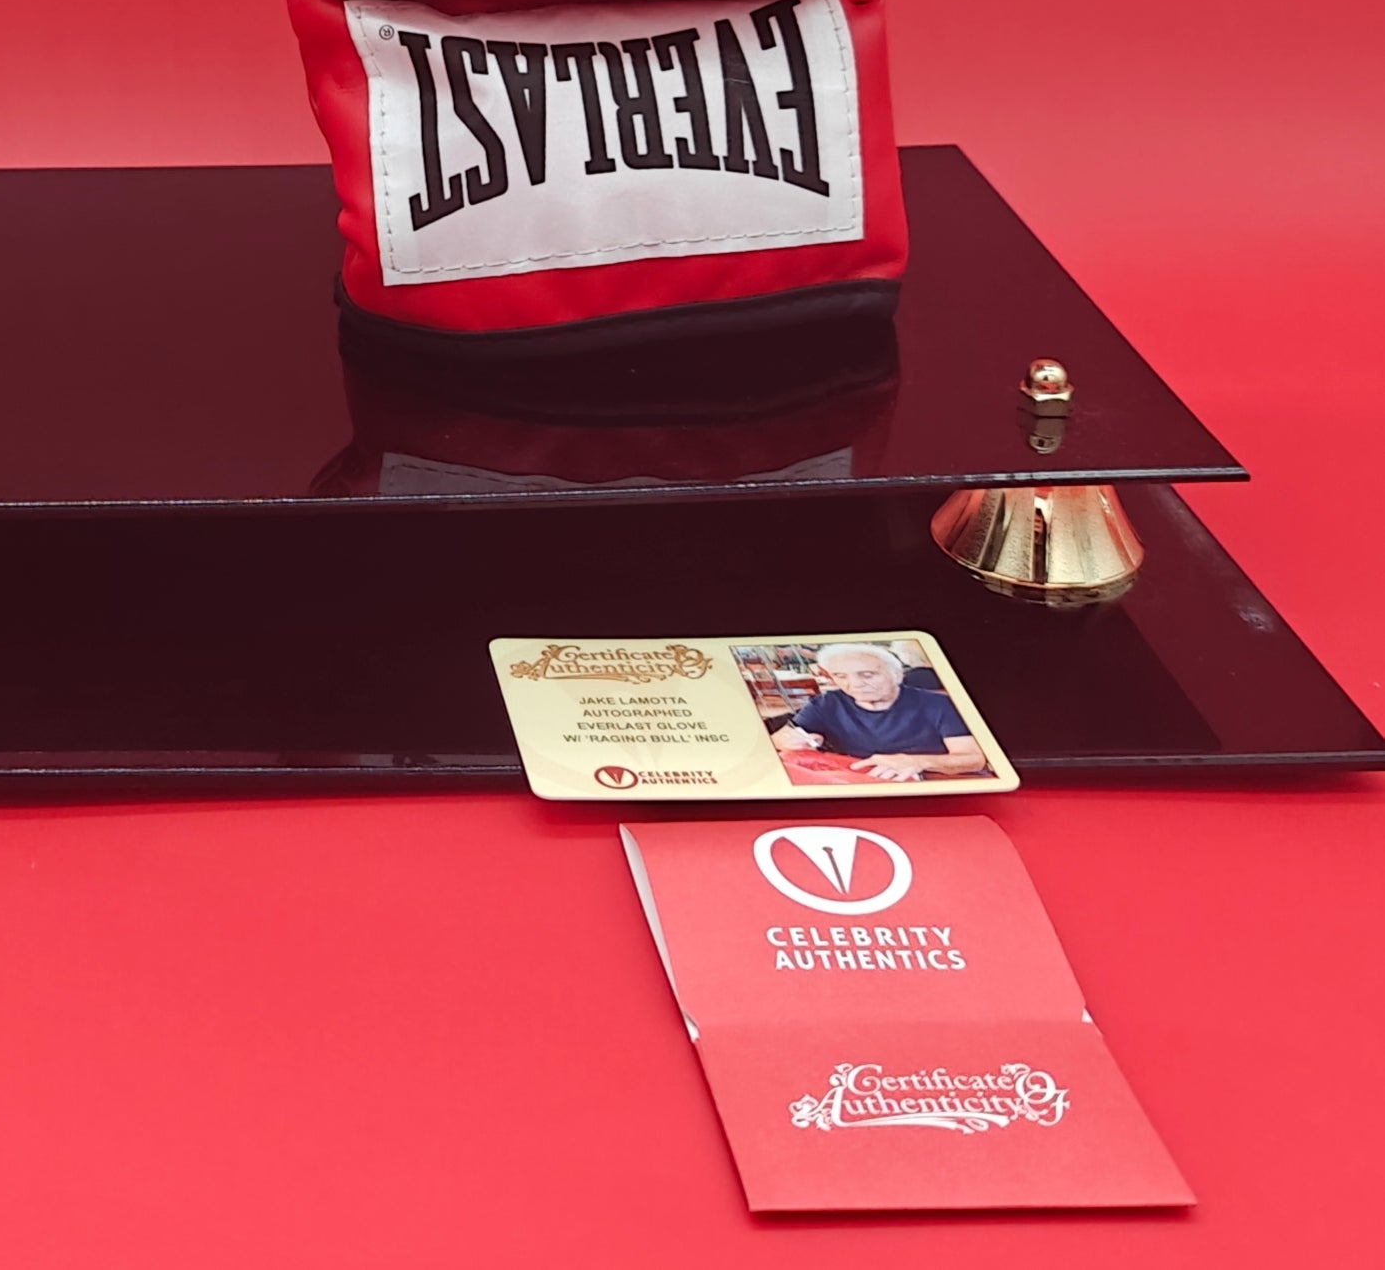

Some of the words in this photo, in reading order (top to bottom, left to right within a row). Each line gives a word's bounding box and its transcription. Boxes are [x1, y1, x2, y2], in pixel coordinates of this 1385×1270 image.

[541, 644, 674, 663] Certificate
[510, 656, 676, 684] Authenticity
[579, 697, 616, 705] JAKE
[619, 697, 688, 705] LAMOTTA
[583, 709, 693, 718] AUTOGRAPHED
[577, 721, 652, 730] EVERLAST
[657, 721, 708, 730] GLOVE
[695, 734, 730, 742] INSC
[638, 770, 714, 778] CELEBRITY
[640, 777, 719, 785] AUTHENTICS
[766, 926, 953, 948] CELEBRITY
[775, 949, 967, 970] AUTHENTICS
[829, 1063, 1015, 1096] Certificate
[789, 1086, 1022, 1134] Authenticity
